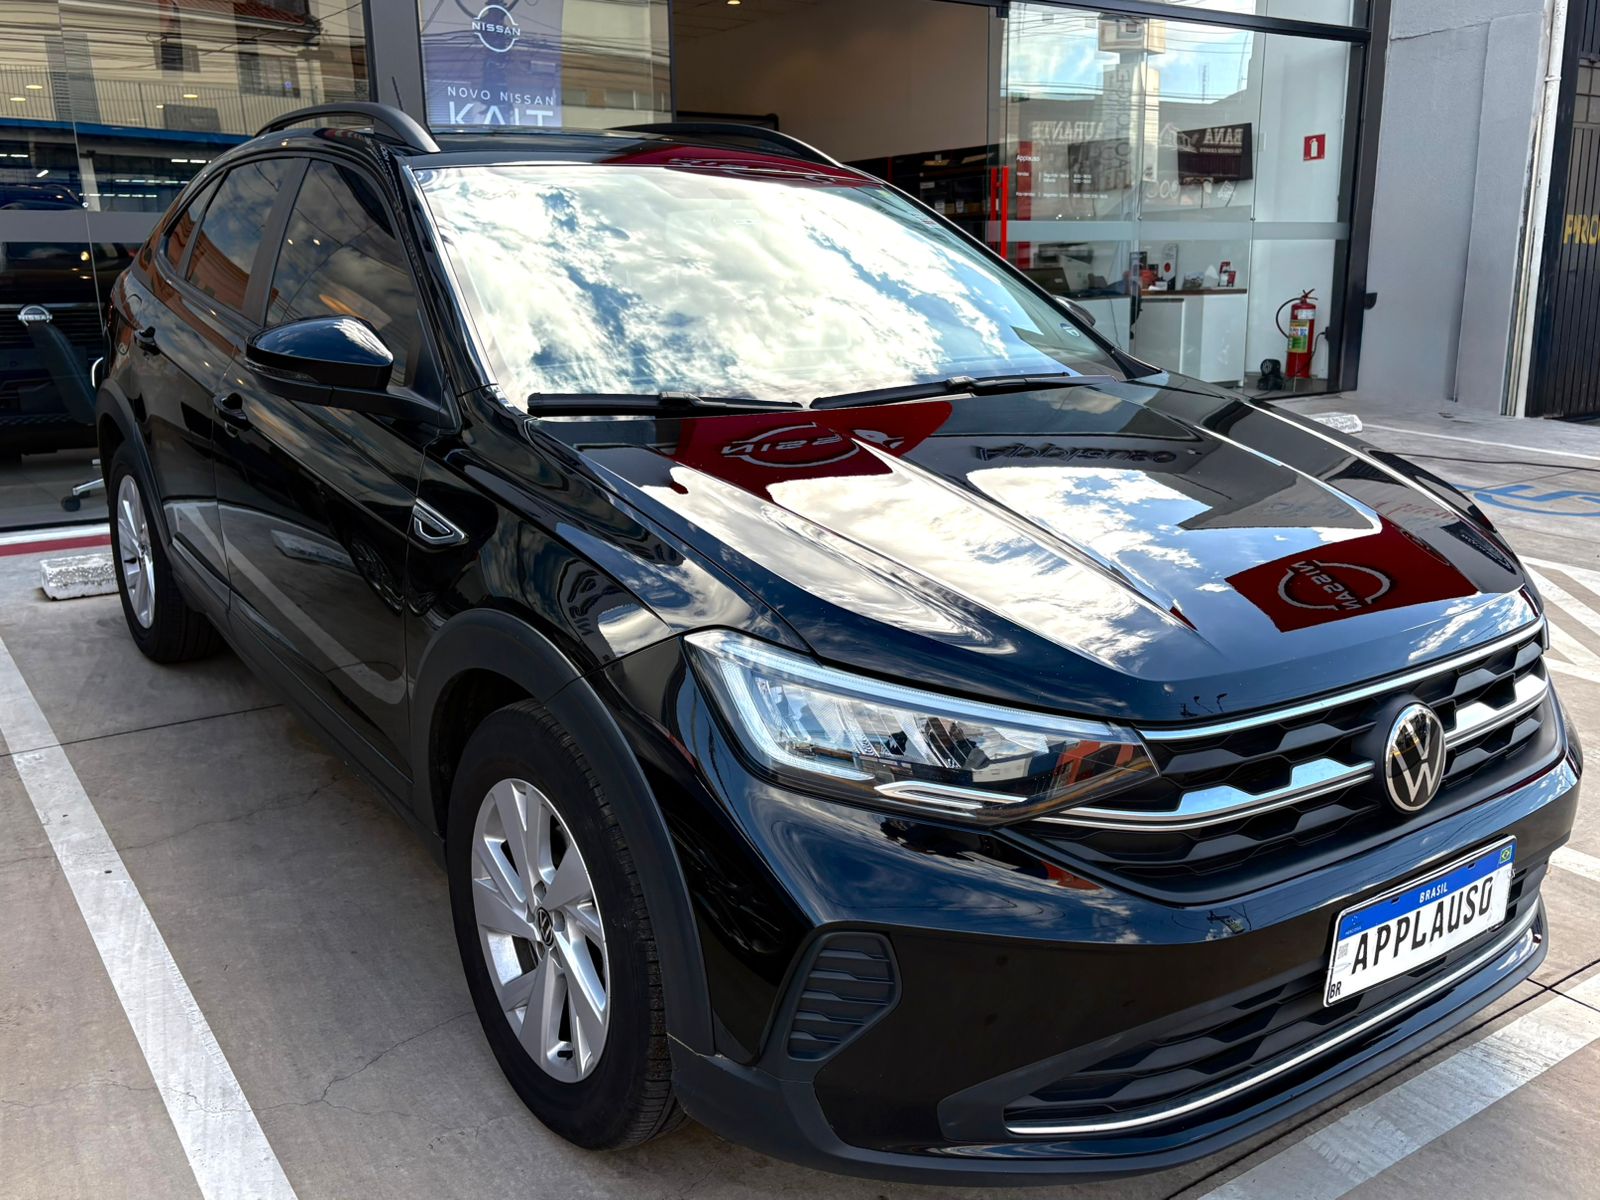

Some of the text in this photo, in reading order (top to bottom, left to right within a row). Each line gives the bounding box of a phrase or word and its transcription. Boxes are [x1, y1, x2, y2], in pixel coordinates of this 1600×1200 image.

[472, 21, 521, 36] NISSAN
[447, 86, 555, 106] NOVO NISSAN
[1563, 214, 1600, 245] PRO
[1419, 881, 1448, 903] BRASIL
[1351, 876, 1494, 975] APPLAUSO
[1329, 981, 1342, 999] BR
